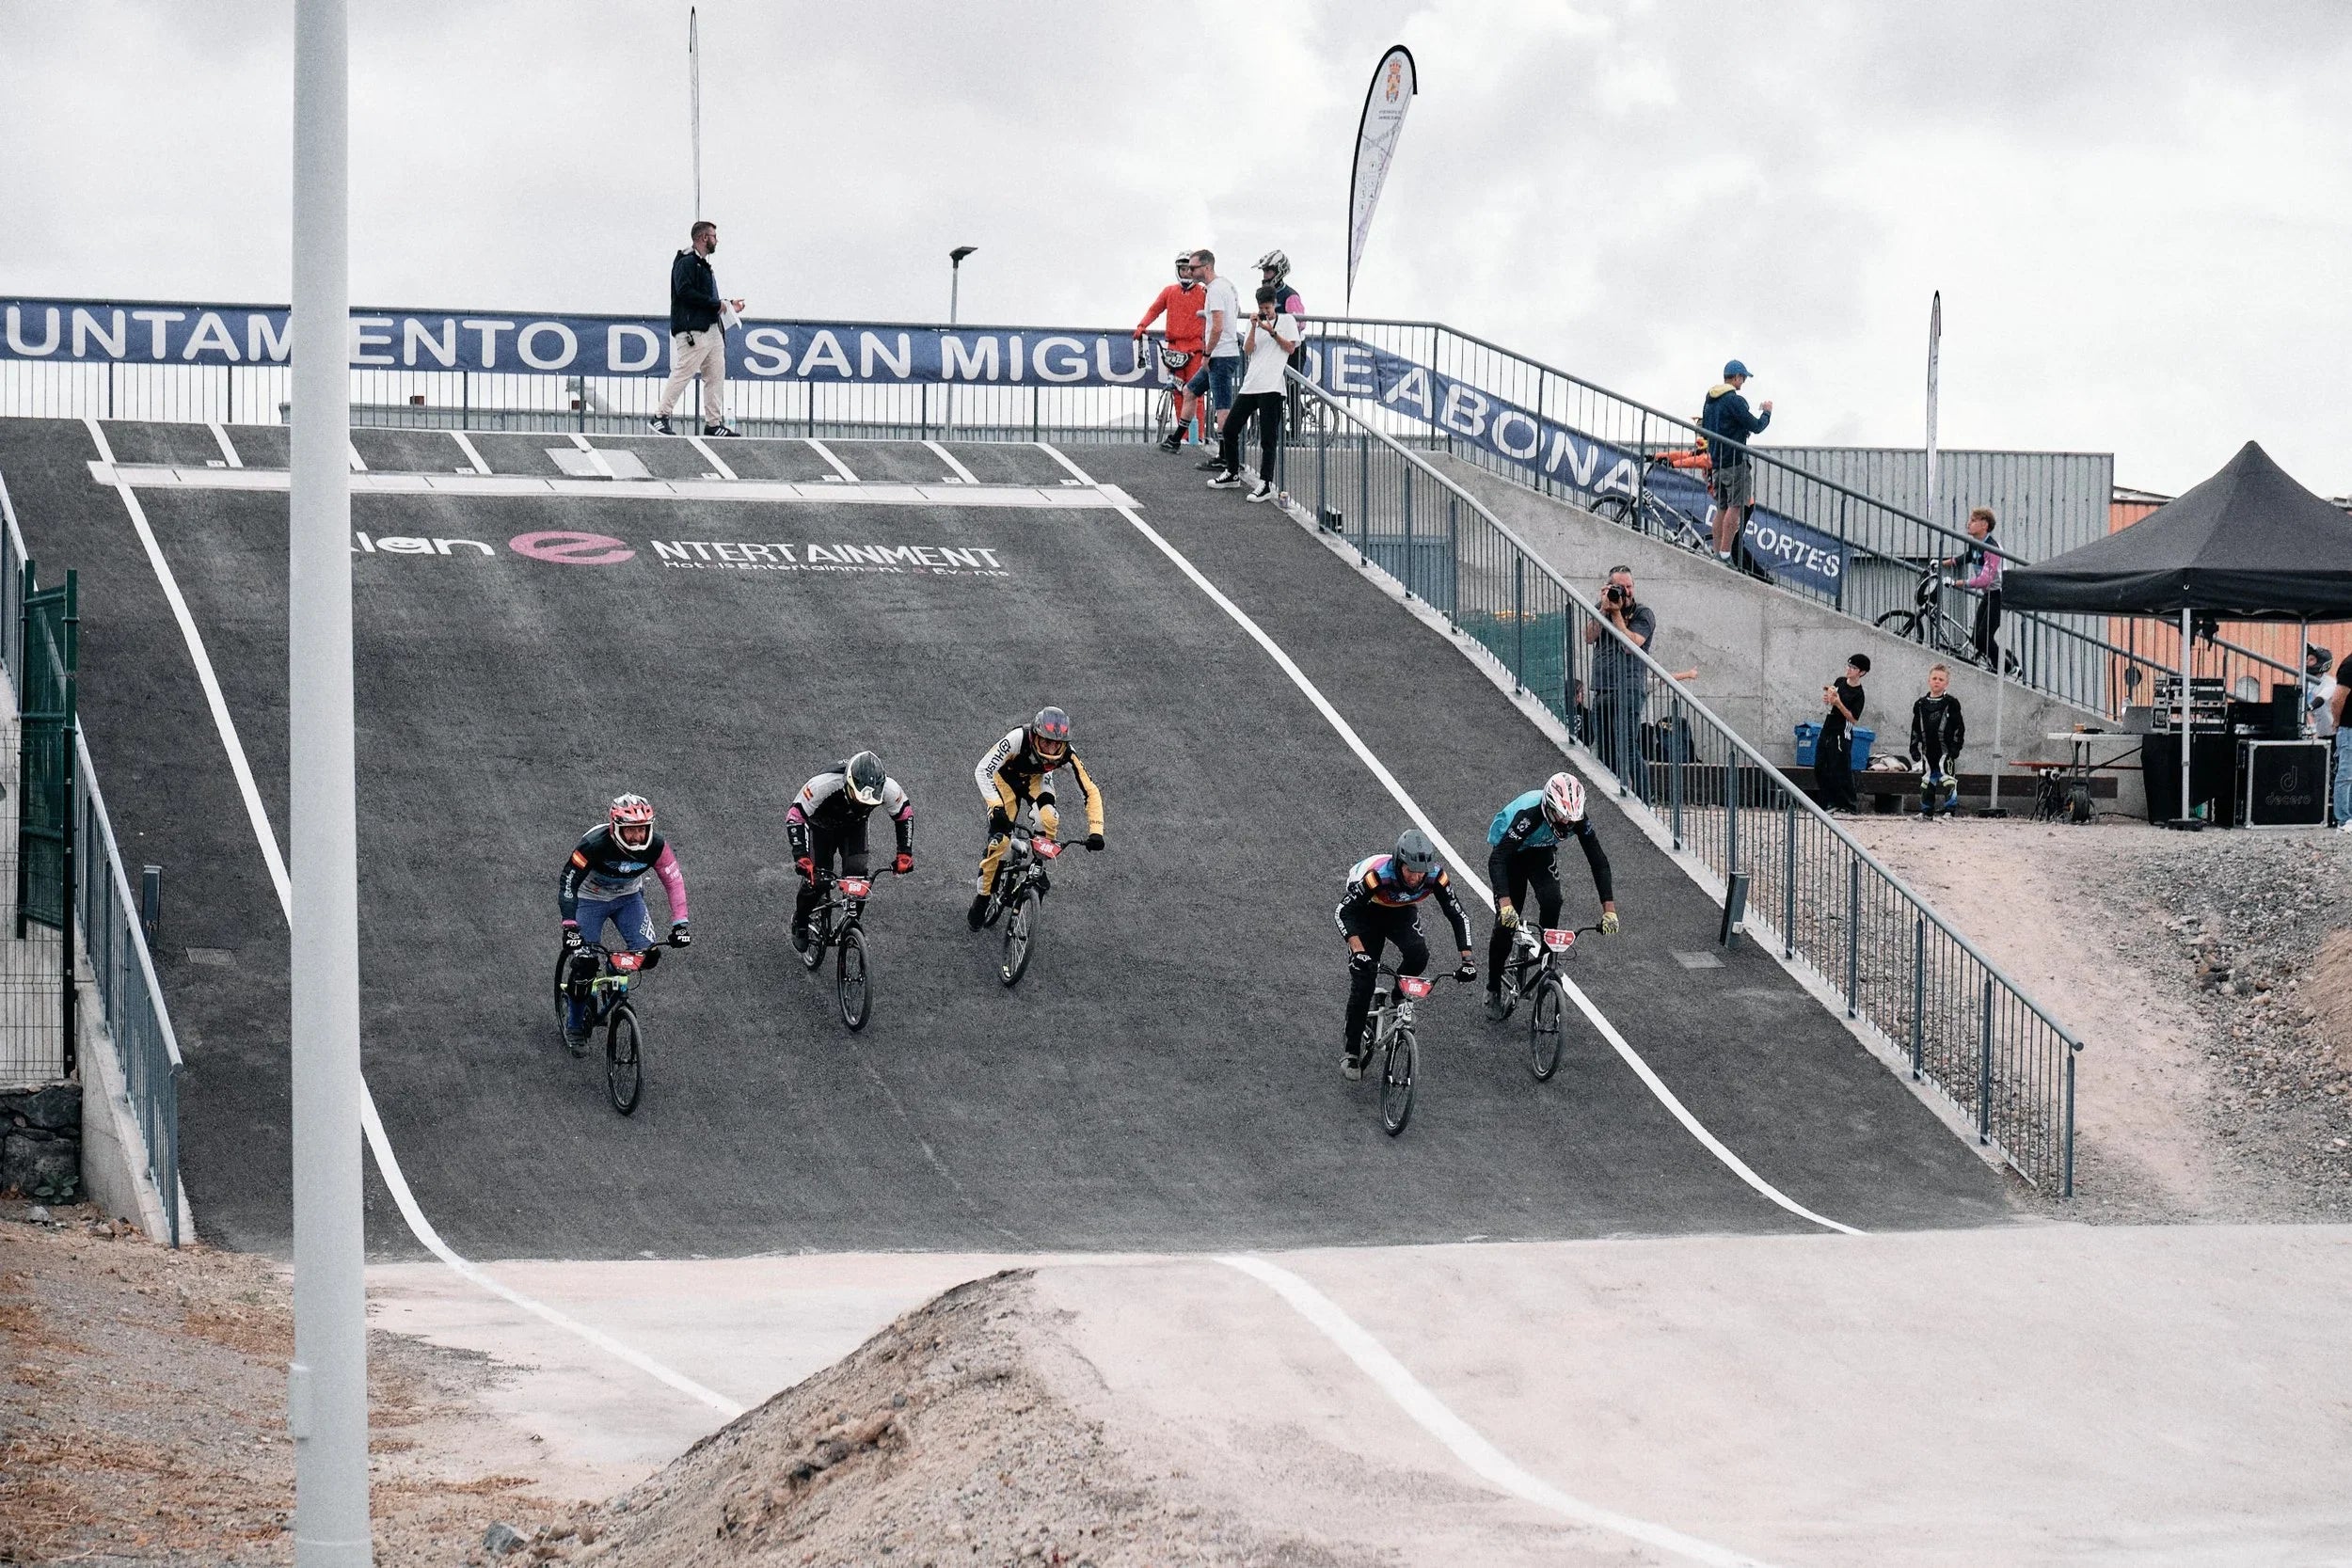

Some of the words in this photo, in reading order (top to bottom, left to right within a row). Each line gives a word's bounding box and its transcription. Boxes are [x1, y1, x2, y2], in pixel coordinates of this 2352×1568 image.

[7, 306, 578, 370] UNTAMENTO
[743, 328, 911, 379] SAN
[941, 335, 1168, 384] MIGU
[1386, 367, 1640, 499] ABONA
[1705, 504, 1840, 578] DPORTES
